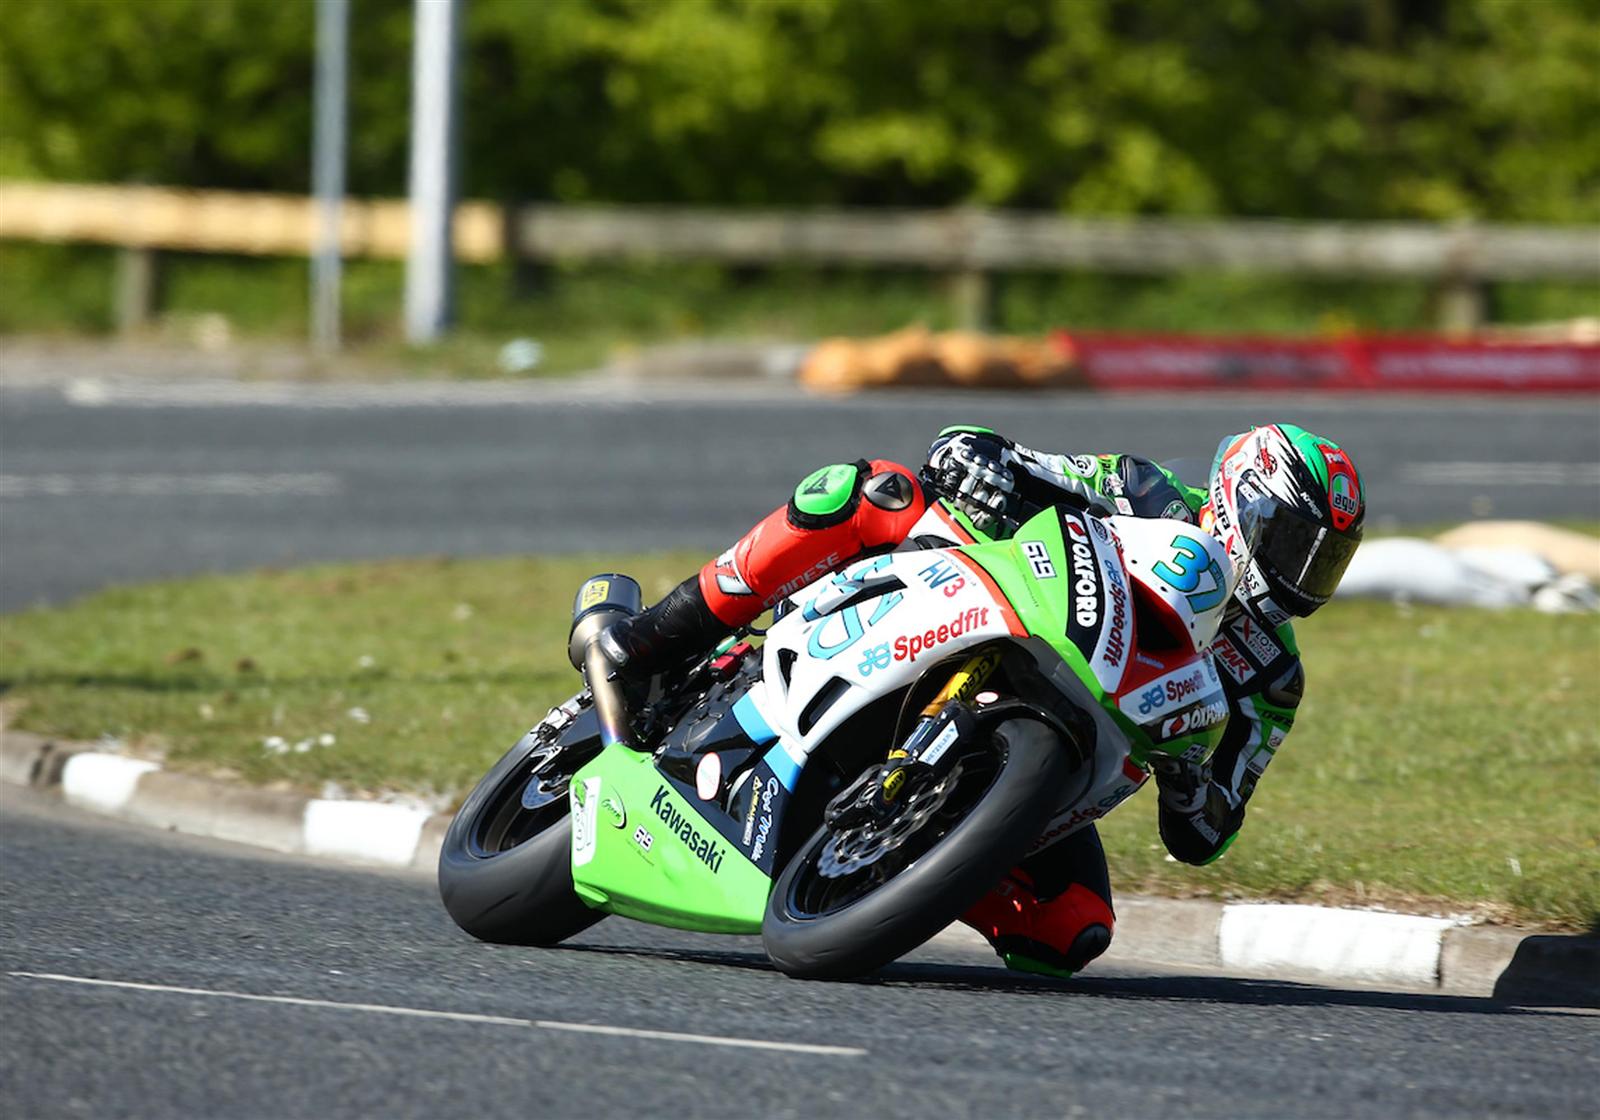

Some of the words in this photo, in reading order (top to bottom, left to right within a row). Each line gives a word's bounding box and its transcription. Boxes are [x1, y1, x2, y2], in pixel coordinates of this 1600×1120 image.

[1071, 541, 1098, 628] OXFORD
[1152, 535, 1227, 614] 37
[893, 607, 990, 663] Speedfit
[1103, 580, 1127, 669] Speedfit
[650, 784, 726, 874] Kawasaki
